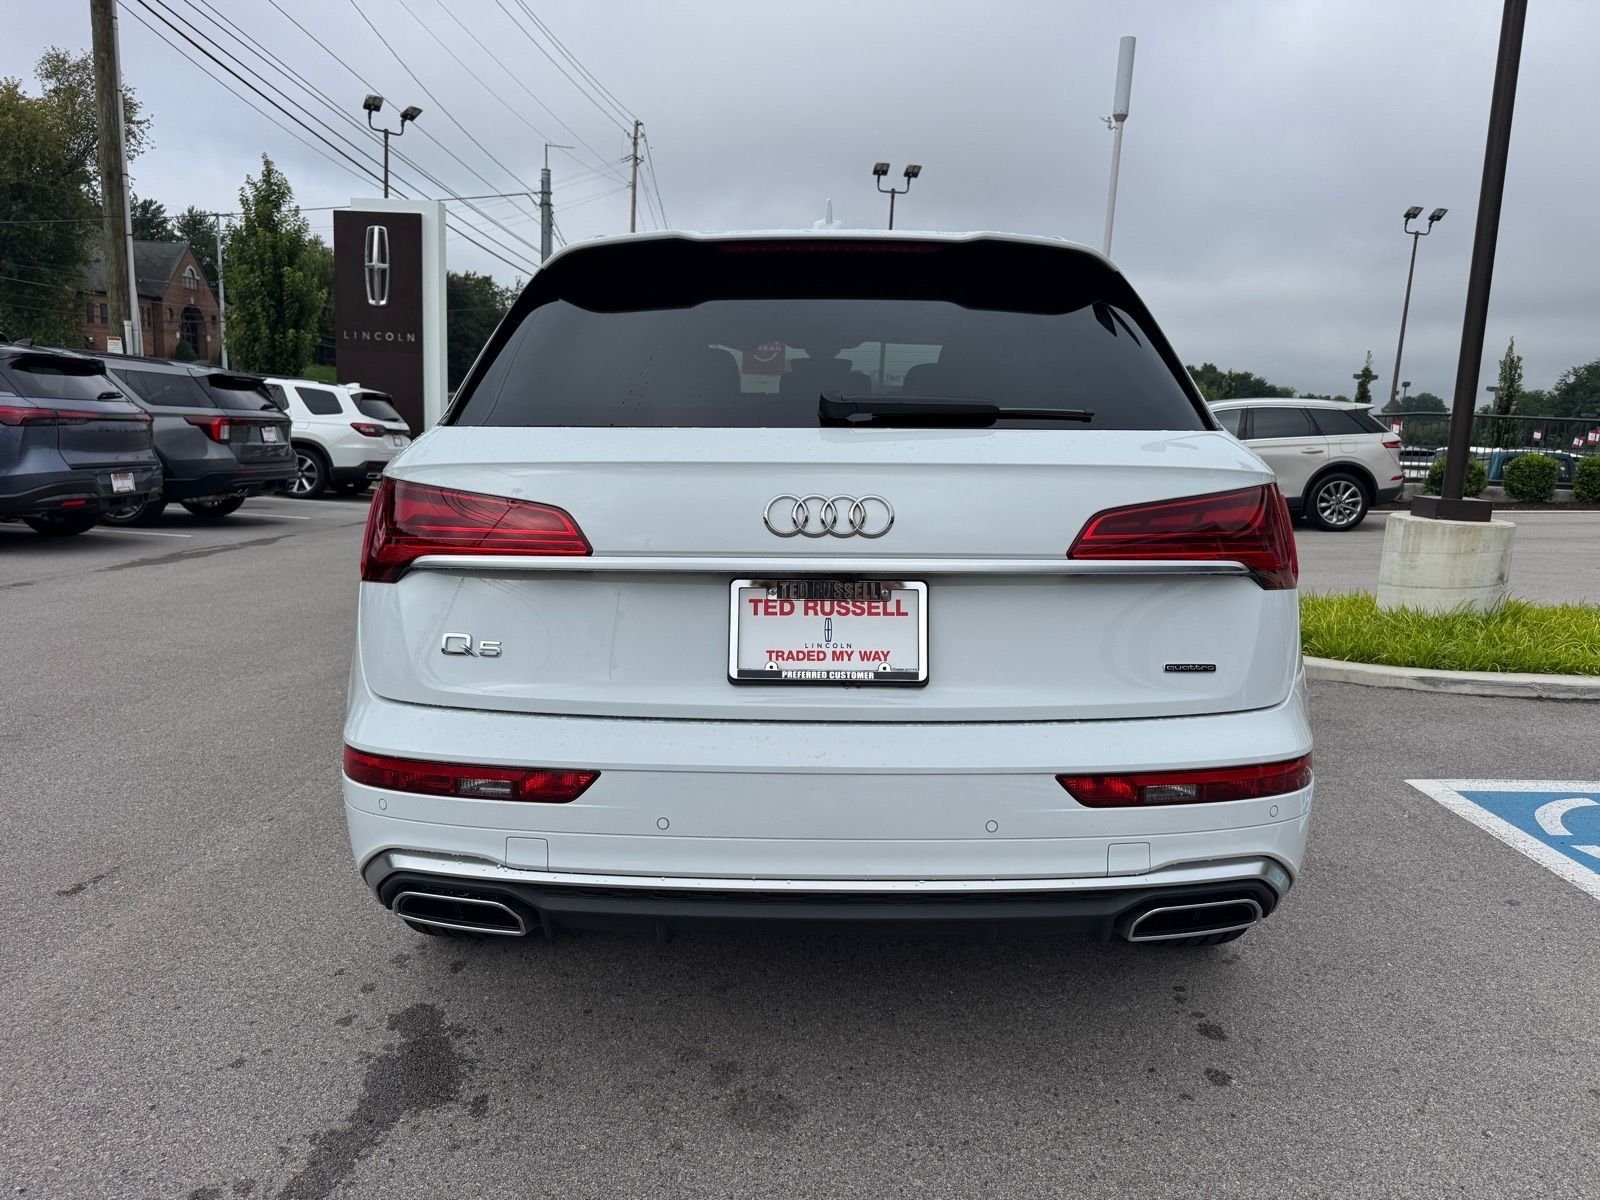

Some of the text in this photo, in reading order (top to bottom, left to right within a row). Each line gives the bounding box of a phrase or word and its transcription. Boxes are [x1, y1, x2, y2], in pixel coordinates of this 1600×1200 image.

[343, 330, 416, 342] LINCOLN
[779, 581, 879, 600] TED RUSSELL
[748, 598, 909, 617] TED RUSSELL
[441, 632, 502, 657] Q5
[766, 650, 891, 662] TRADED MY WAY
[1166, 664, 1215, 672] quattro
[781, 670, 874, 679] PREFERRED CUSTOMER
